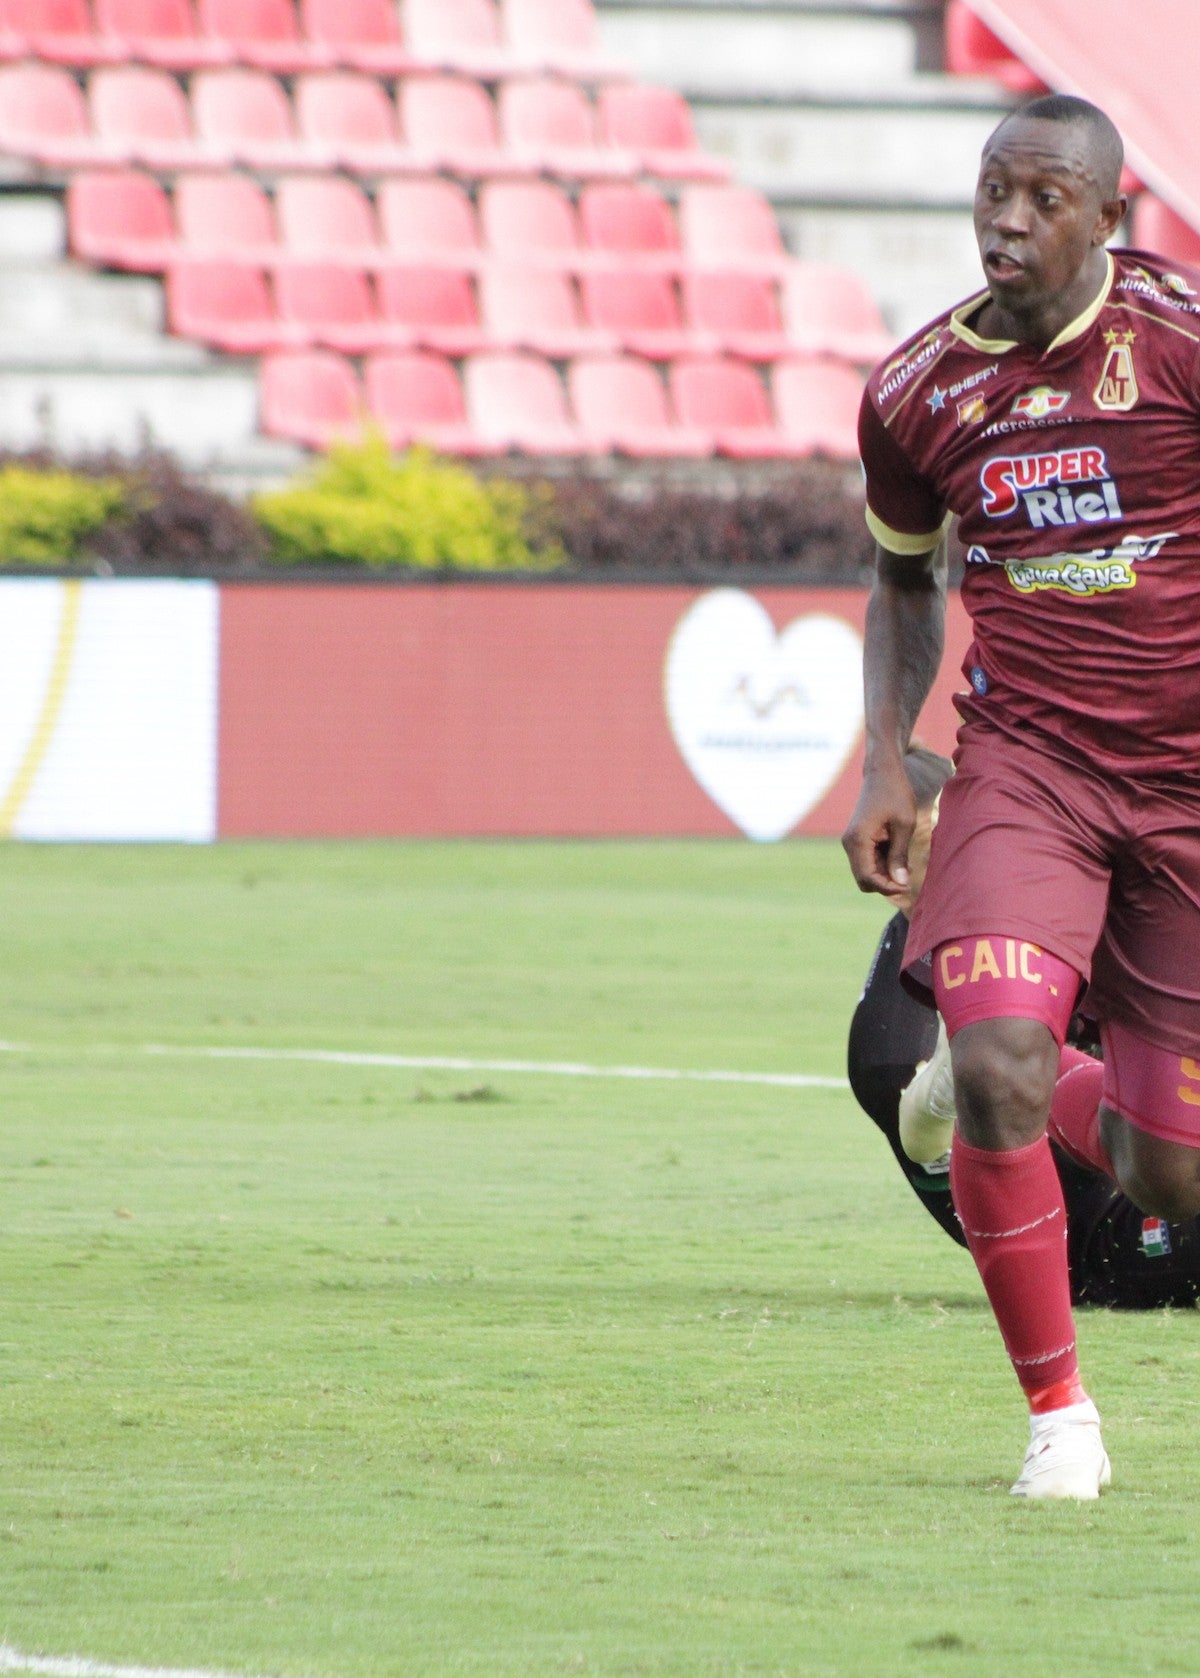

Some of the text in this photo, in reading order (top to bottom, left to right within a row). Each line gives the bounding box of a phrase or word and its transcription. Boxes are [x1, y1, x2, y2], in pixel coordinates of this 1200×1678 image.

[949, 363, 999, 398] SHEFFY
[981, 446, 1110, 518] SUPER
[1021, 481, 1123, 529] Riel
[940, 939, 1058, 996] CAIC
